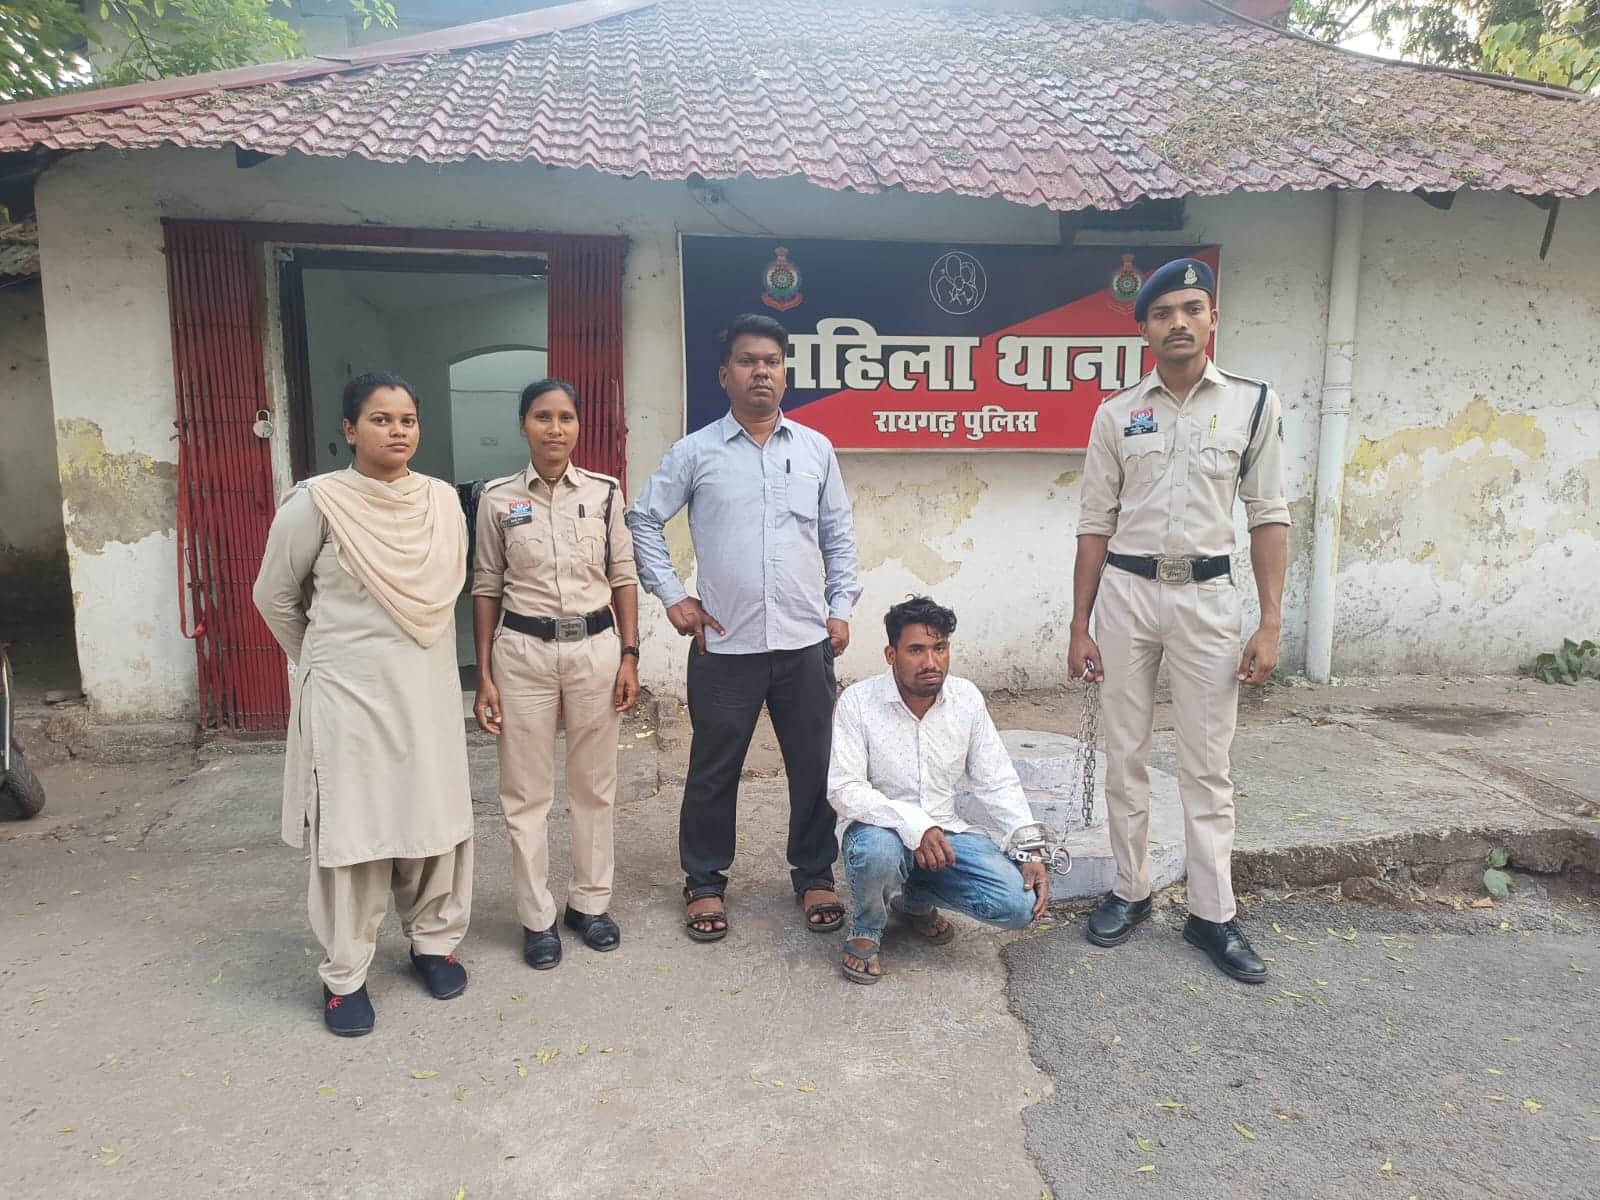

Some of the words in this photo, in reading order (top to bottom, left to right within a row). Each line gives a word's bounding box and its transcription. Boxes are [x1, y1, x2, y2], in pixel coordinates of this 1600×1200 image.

[998, 335, 1149, 391] थाना
[872, 410, 958, 438] रायगढ़
[962, 404, 1039, 440] पुलिस
